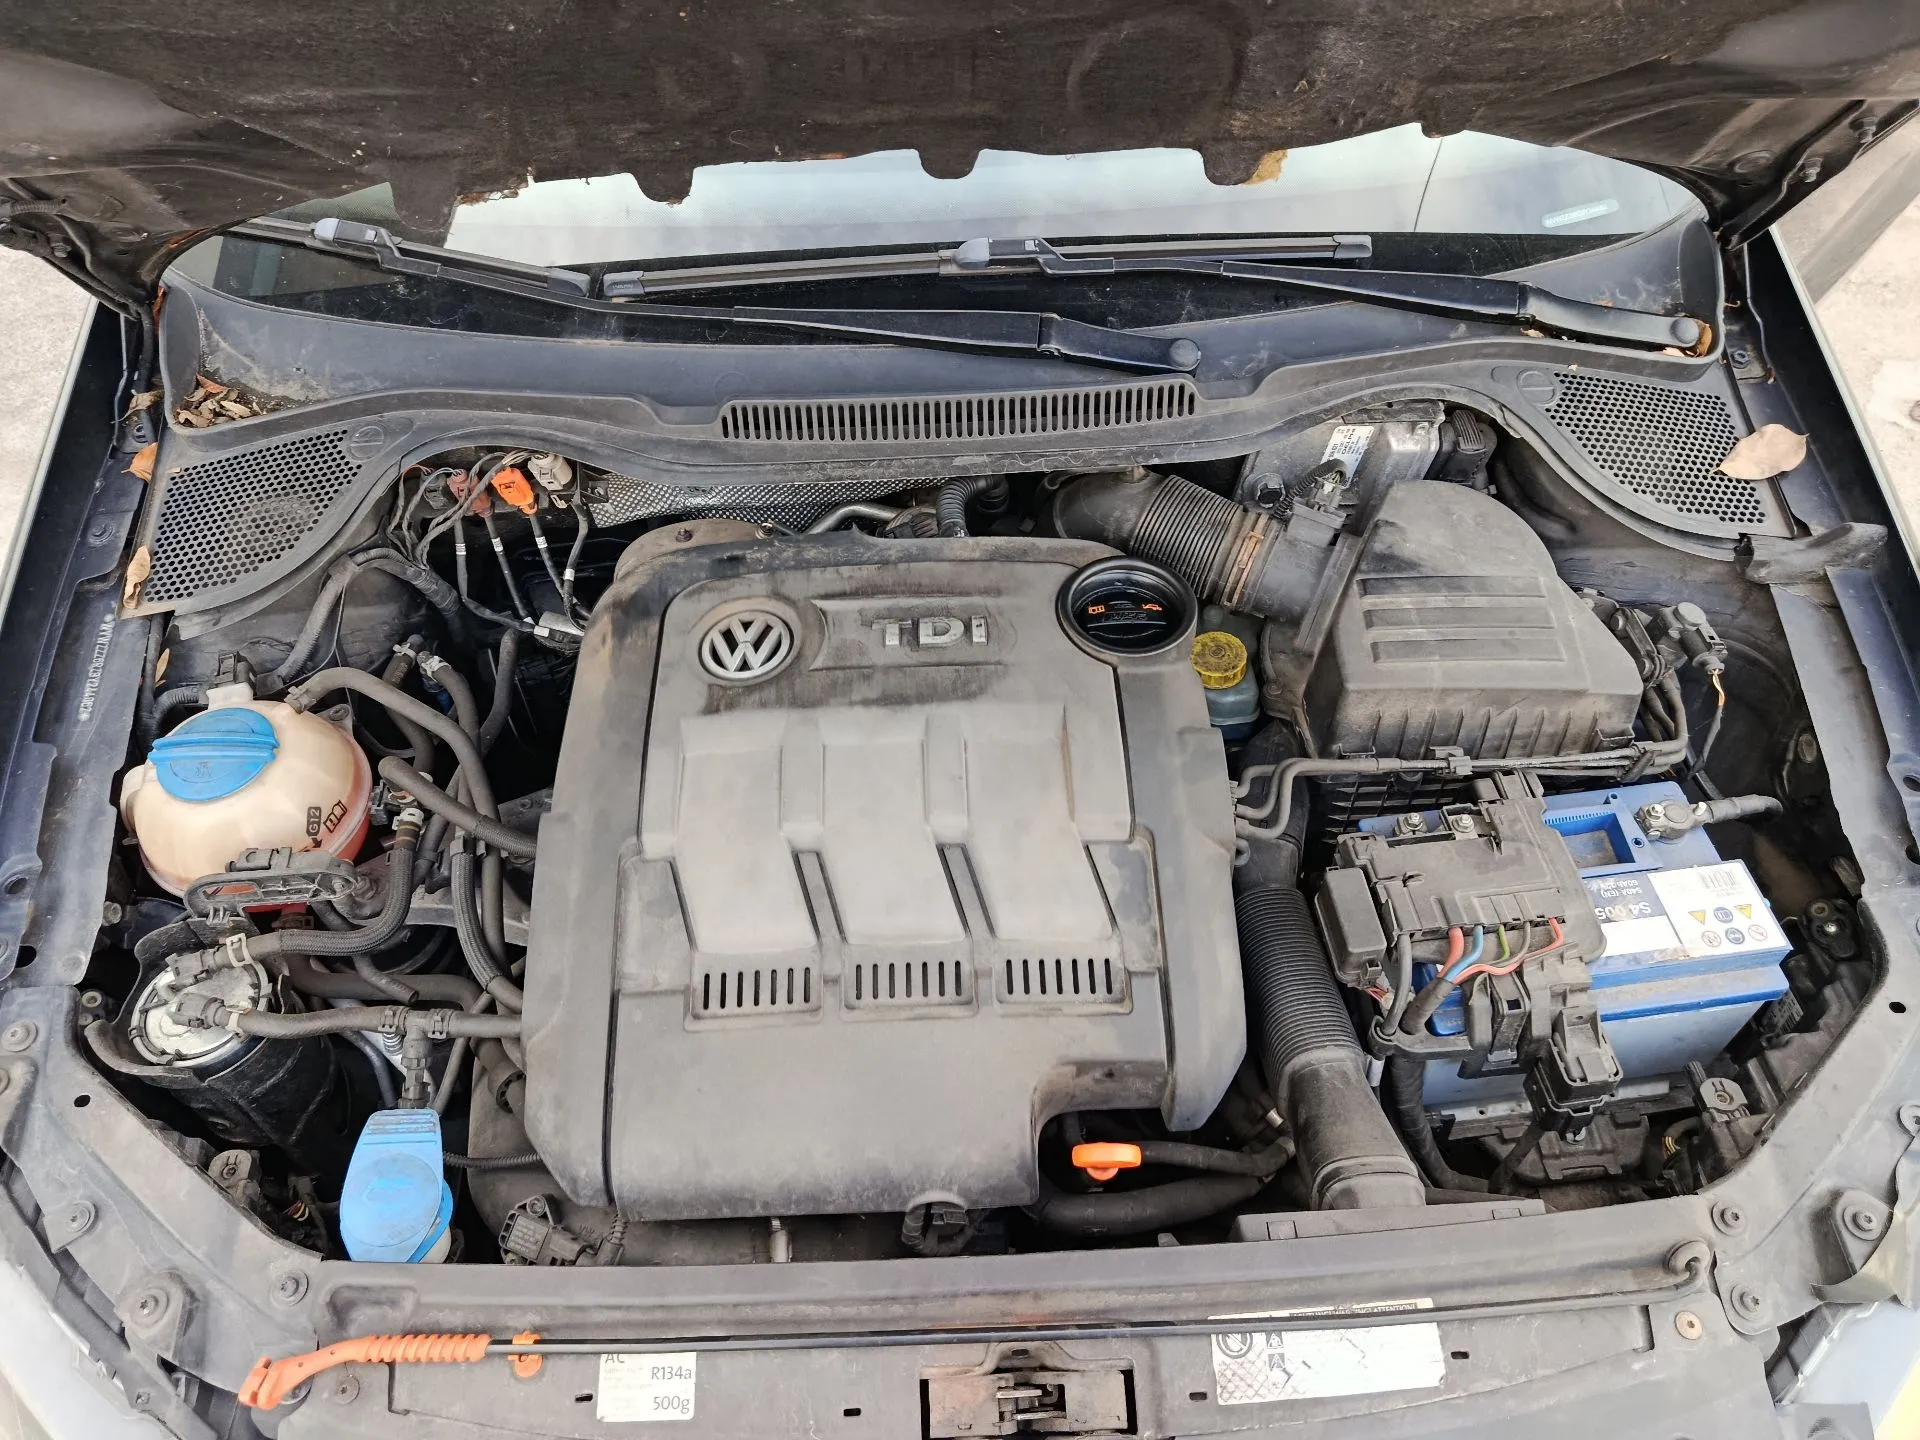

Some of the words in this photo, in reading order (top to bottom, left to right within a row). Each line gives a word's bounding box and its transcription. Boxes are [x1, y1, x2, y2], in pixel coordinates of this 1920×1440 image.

[872, 615, 989, 647] TDI
[704, 612, 790, 678] VW
[308, 808, 320, 833] G12
[651, 1365, 692, 1381] R134a
[653, 1395, 691, 1415] 500g
